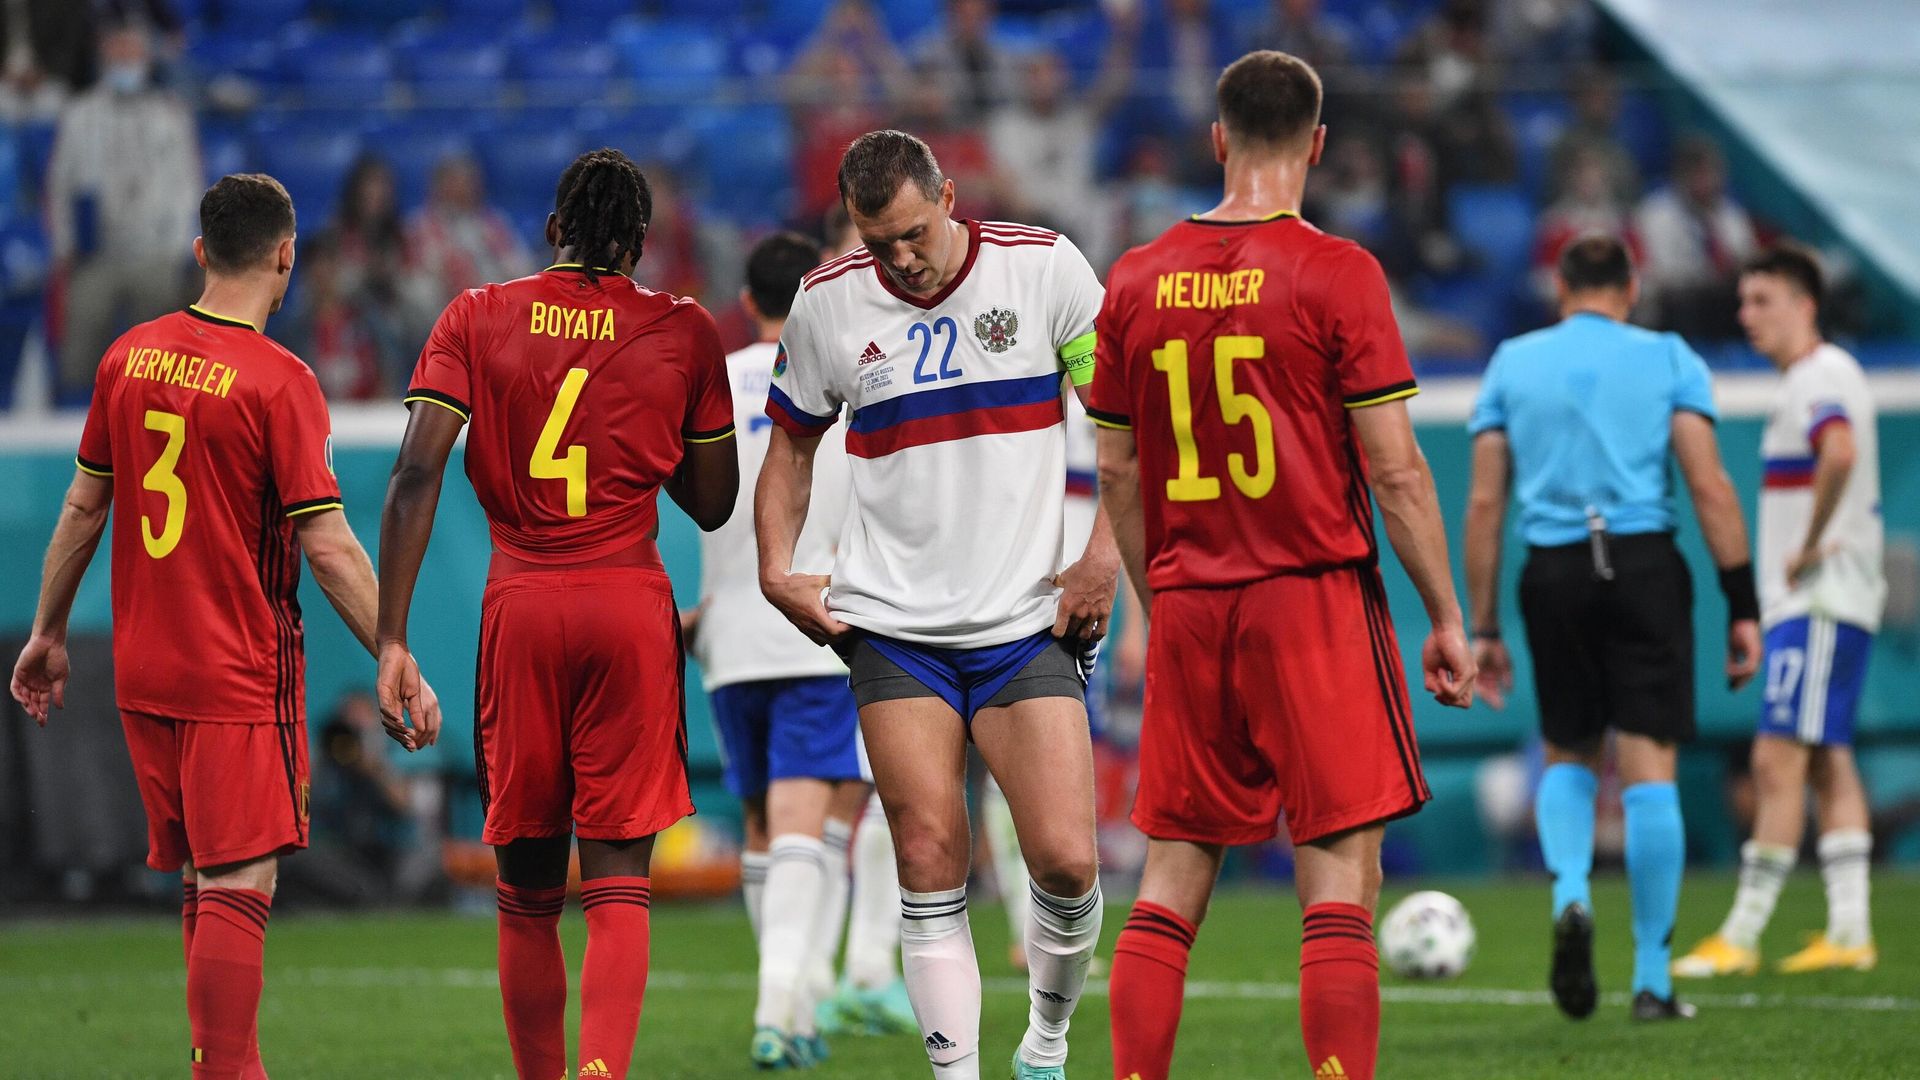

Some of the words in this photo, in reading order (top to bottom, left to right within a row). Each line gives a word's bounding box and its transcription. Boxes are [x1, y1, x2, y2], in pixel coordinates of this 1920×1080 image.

[529, 301, 615, 341] BOYATA
[124, 346, 238, 399] VERMAELEN
[858, 353, 886, 365] adidas
[907, 316, 963, 385] 22
[529, 367, 589, 517] 4
[1151, 335, 1276, 501] 15
[141, 409, 188, 560] 3
[1766, 646, 1804, 703] 17
[579, 1069, 612, 1079] adidas
